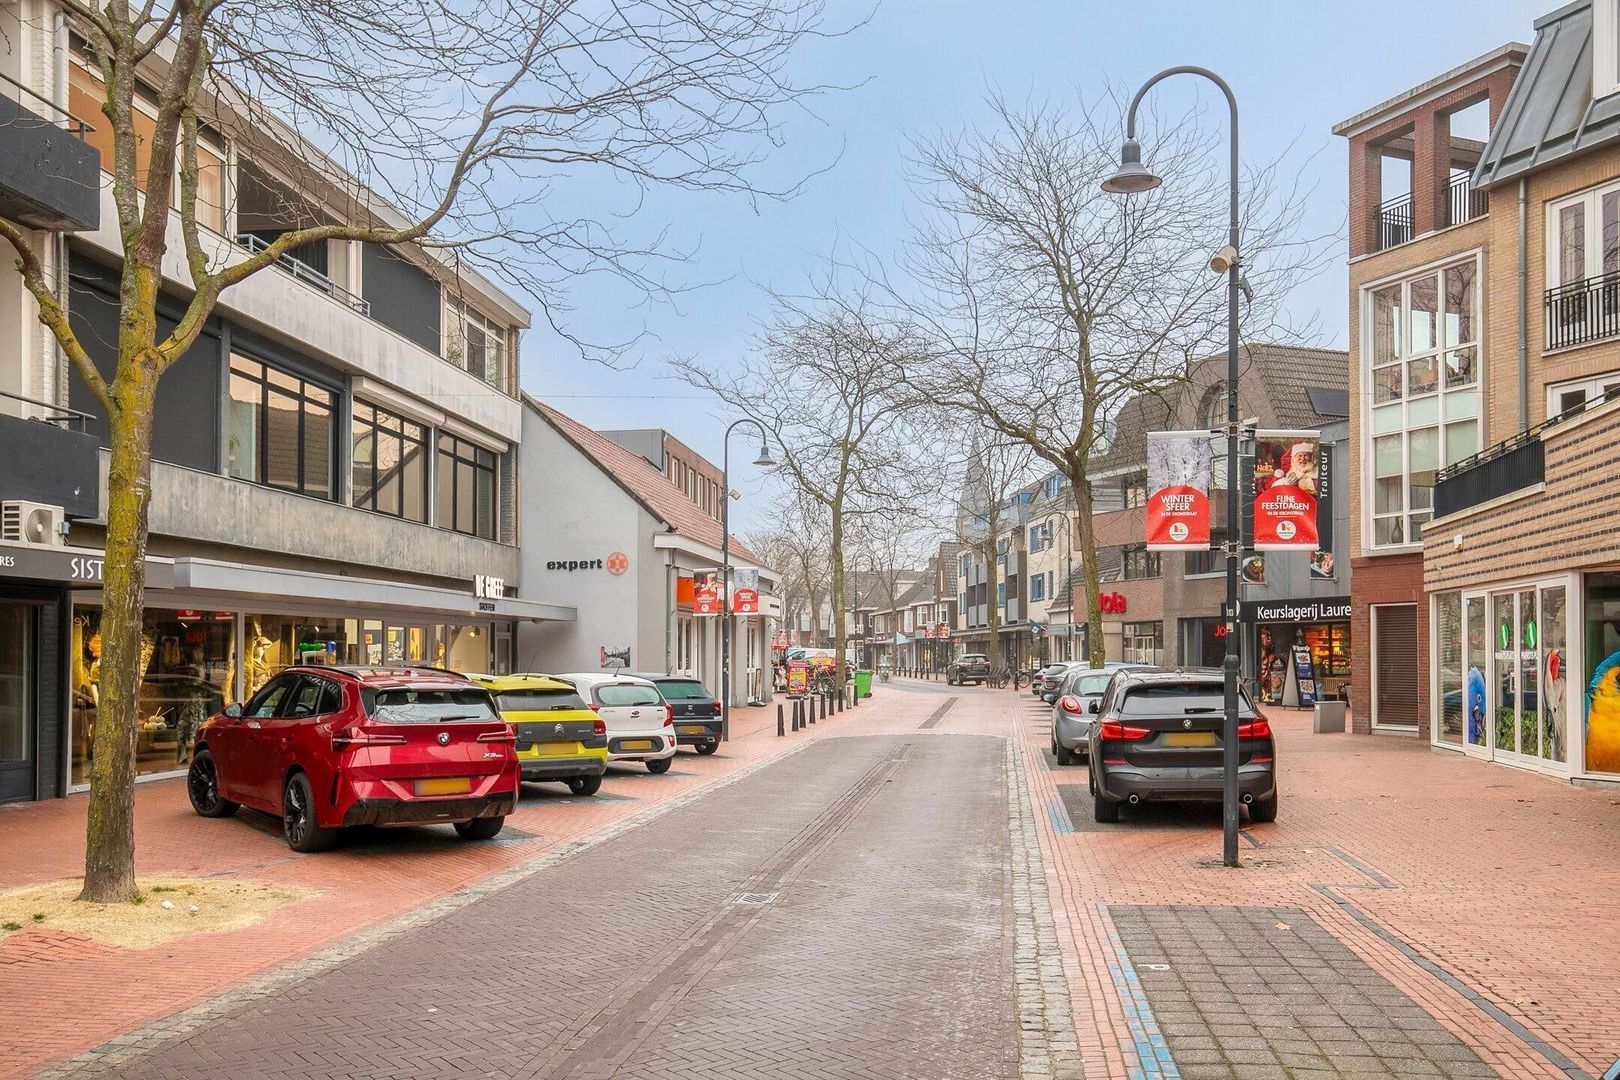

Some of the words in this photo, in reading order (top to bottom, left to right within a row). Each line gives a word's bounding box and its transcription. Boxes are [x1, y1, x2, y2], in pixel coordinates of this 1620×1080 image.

[1319, 451, 1328, 499] Traiteur
[1160, 494, 1195, 503] WINTER
[1276, 495, 1296, 503] FIJNE
[1165, 502, 1191, 511] SFEER
[1261, 502, 1310, 511] FEESTDAGEN
[71, 557, 104, 580] SIST
[546, 558, 603, 572] expert
[1257, 604, 1318, 621] Keurslagerij
[1320, 603, 1351, 617] Laure
